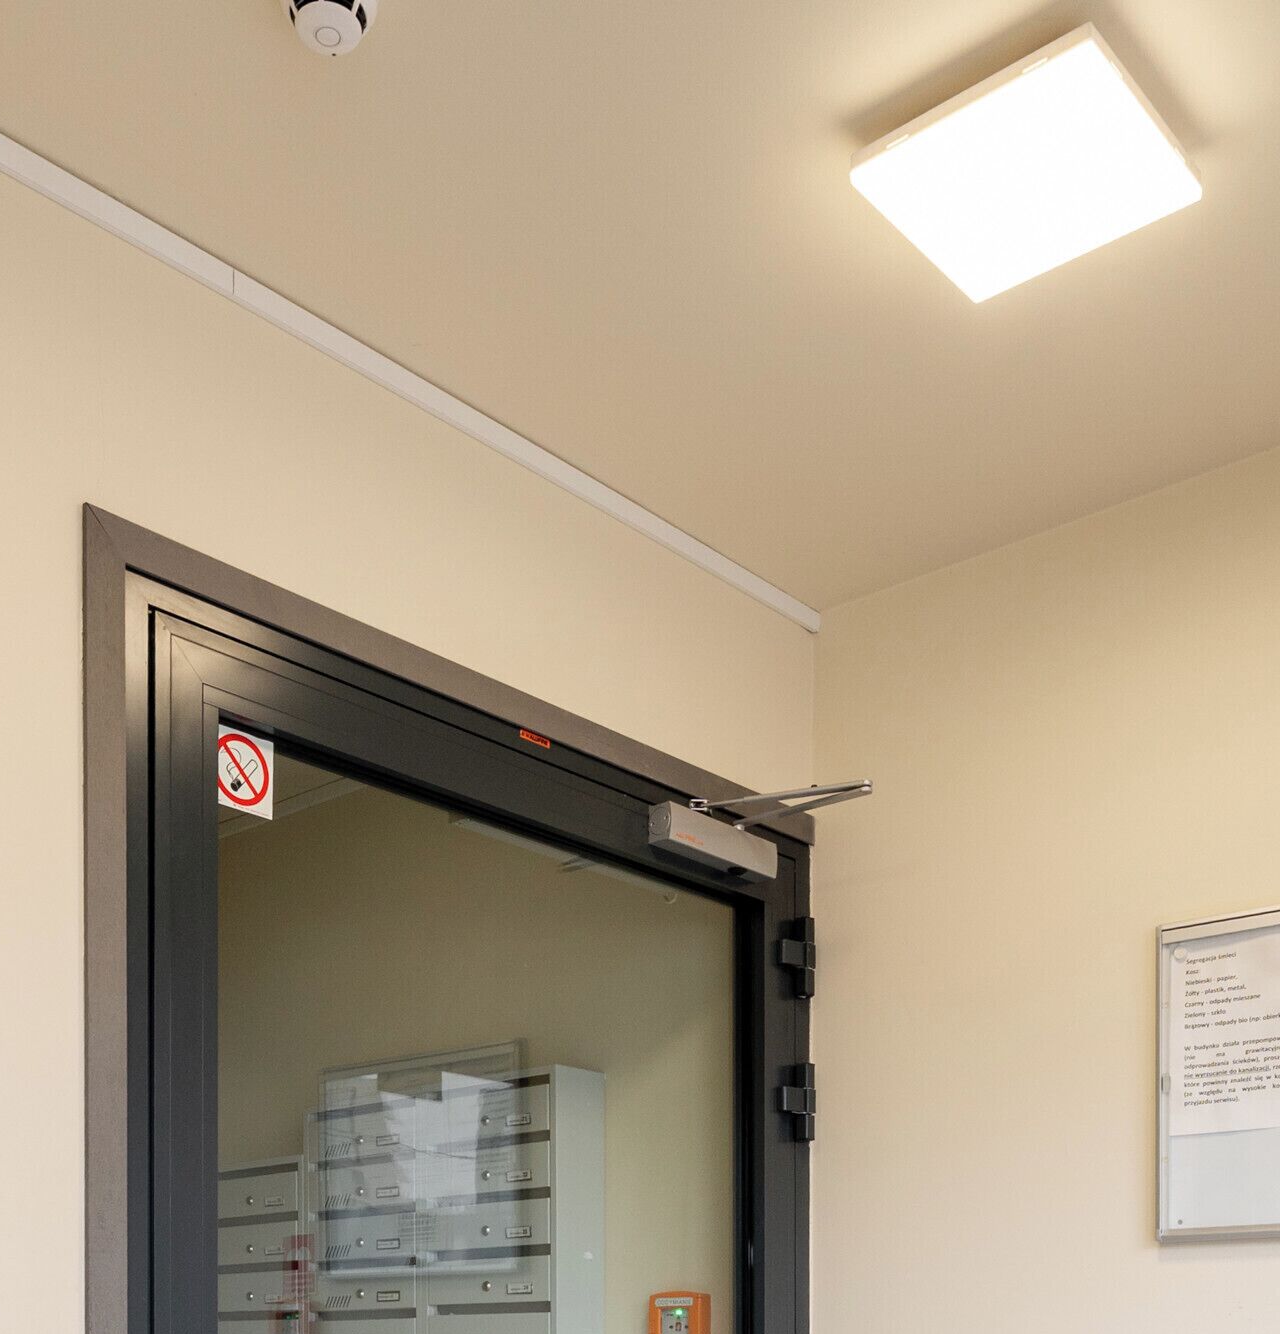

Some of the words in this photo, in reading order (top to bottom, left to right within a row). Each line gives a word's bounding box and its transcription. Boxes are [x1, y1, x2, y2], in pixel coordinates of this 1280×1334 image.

[1186, 956, 1216, 964] Segregacja
[1185, 977, 1212, 986] Niebieski
[1184, 1060, 1229, 1070] odprowadzania
[1195, 1070, 1228, 1078] wyrzucanie
[1242, 1084, 1266, 1092] wysokie
